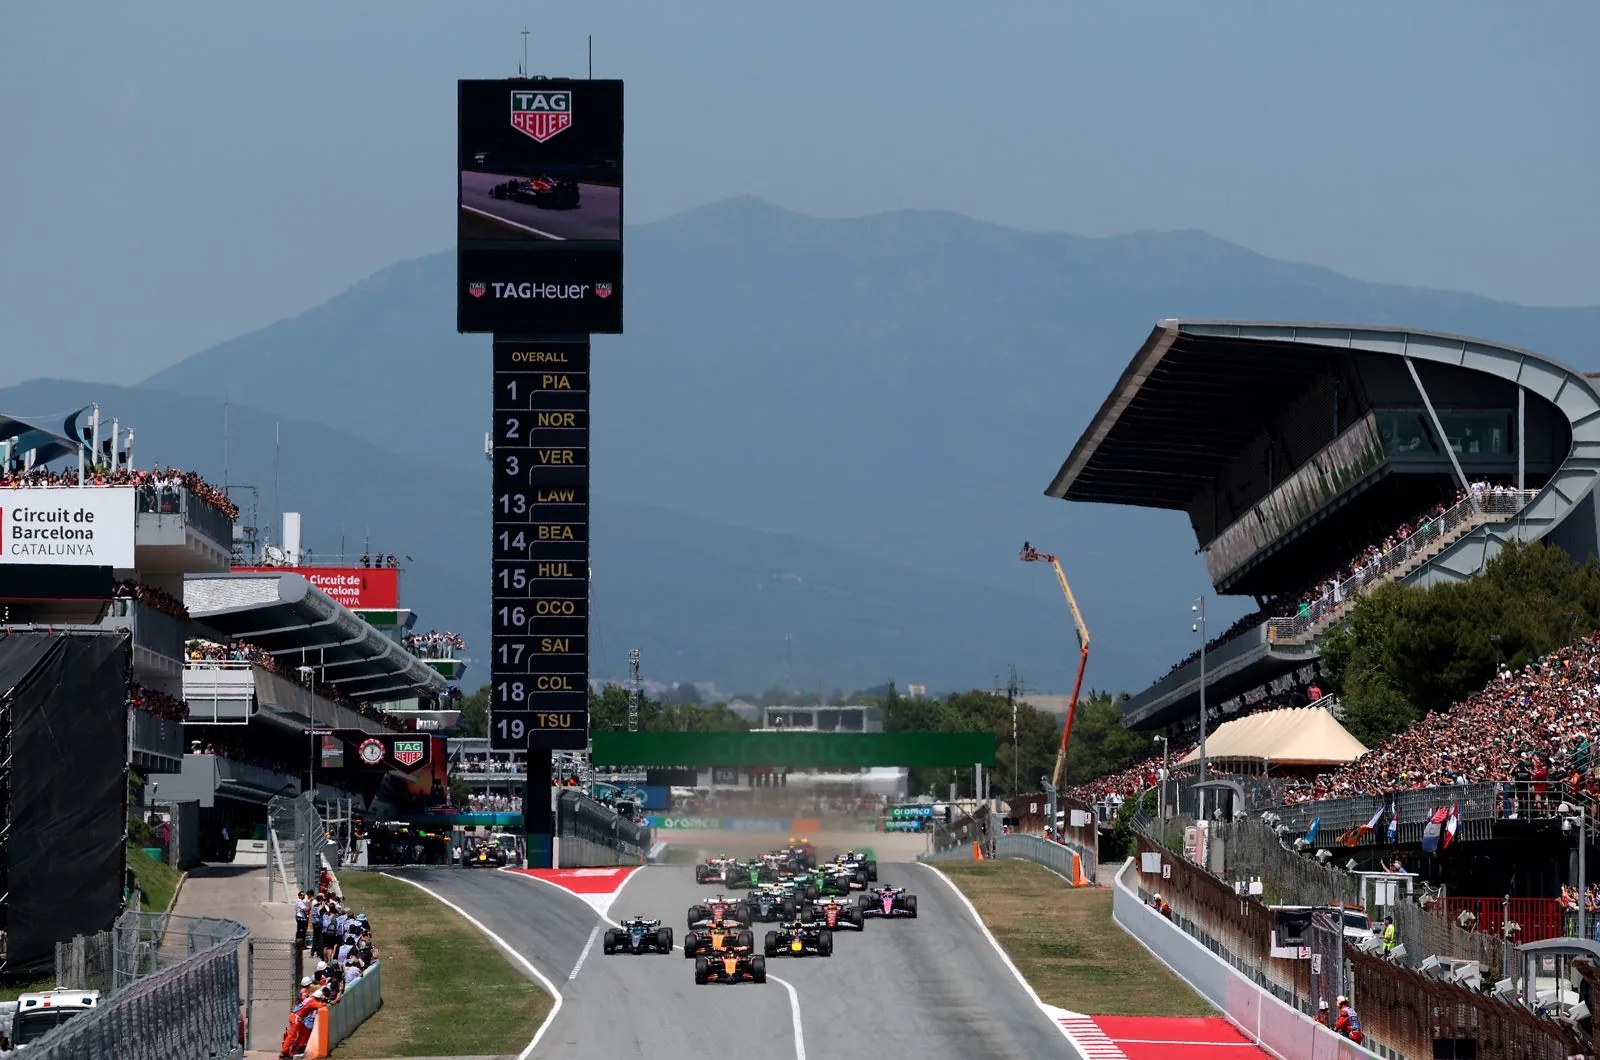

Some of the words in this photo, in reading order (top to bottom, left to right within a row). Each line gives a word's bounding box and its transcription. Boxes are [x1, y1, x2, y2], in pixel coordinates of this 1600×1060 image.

[516, 93, 566, 111] TAG
[514, 114, 569, 138] HEUER
[492, 282, 589, 300] TAGHeuer
[511, 352, 568, 363] OVERALL
[506, 380, 518, 401] 1
[542, 375, 571, 389] PIA
[505, 418, 520, 438] 2
[538, 412, 575, 427] NOR
[505, 455, 520, 476] 3
[539, 450, 574, 464] VER
[499, 493, 526, 514] 13
[538, 489, 574, 502] LAW
[12, 507, 70, 522] Circuit
[73, 507, 94, 522] de
[12, 525, 94, 539] Barcelona
[499, 530, 527, 551] 14
[538, 525, 574, 540] BEA
[11, 543, 94, 555] CATALUNYA
[310, 574, 346, 585] Circuit
[347, 574, 360, 585] de
[498, 568, 526, 589] 15
[538, 563, 573, 577] HUL
[319, 586, 360, 596] rcelona
[498, 606, 526, 626] 16
[536, 600, 575, 615] OCO
[498, 643, 525, 664] 17
[541, 638, 569, 652] SAI
[497, 681, 525, 702] 18
[537, 676, 572, 690] COL
[497, 719, 525, 739] 19
[538, 713, 571, 728] TSU
[396, 752, 422, 764] HEUER
[664, 817, 720, 828] aramco
